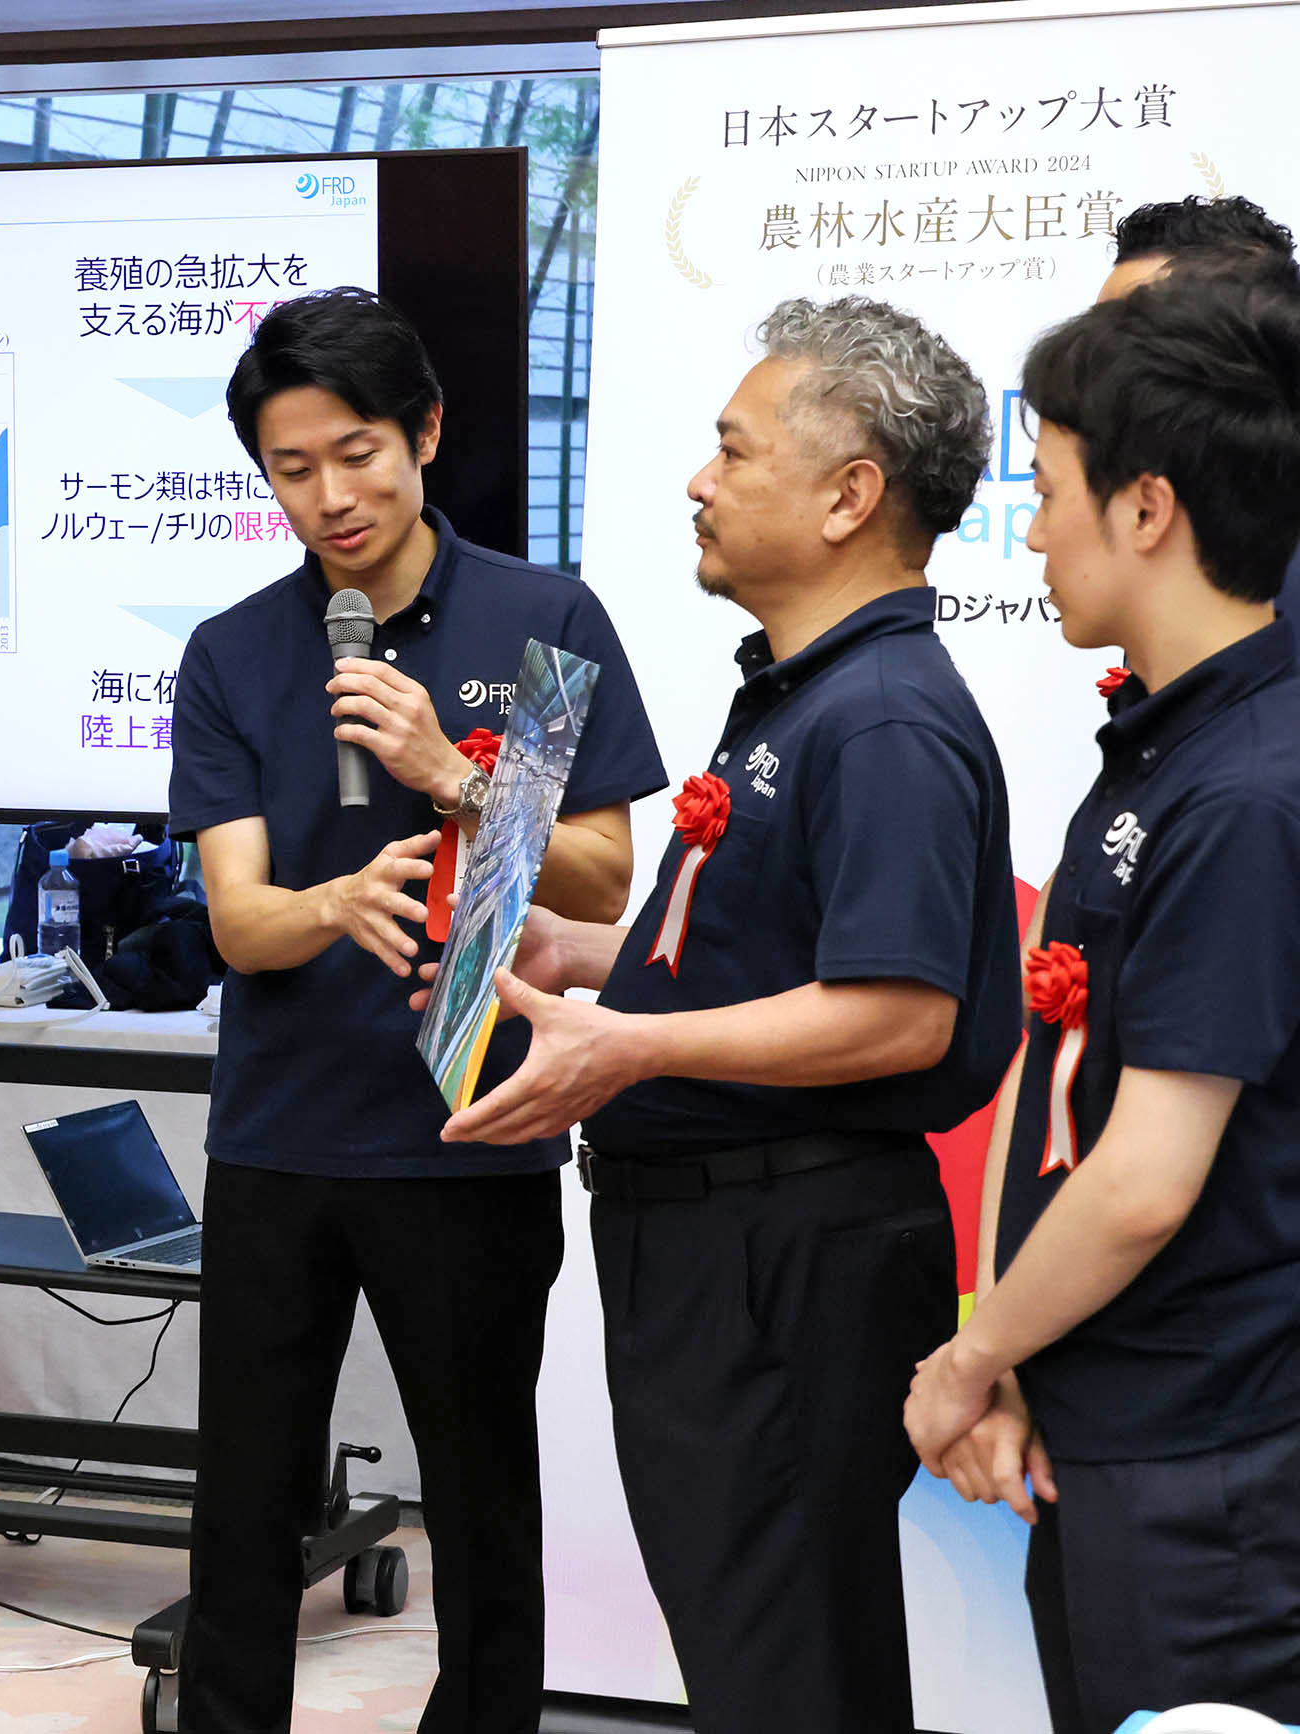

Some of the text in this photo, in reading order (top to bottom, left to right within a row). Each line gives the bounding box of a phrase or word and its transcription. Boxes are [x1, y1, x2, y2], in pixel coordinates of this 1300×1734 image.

[723, 83, 1176, 148] 日本スタートアップ大賞
[795, 154, 1092, 184] NIPPON STARTUP AWARD 2024
[322, 177, 355, 195] FRD
[331, 194, 366, 208] Japan
[759, 190, 1123, 252] 農林水産大臣賞
[74, 253, 308, 292] 養殖の急拡大を
[79, 300, 288, 337] 支える海が不
[60, 471, 278, 501] サーモン類は特に
[937, 594, 1061, 624] Dジャパ
[0, 626, 9, 650] 2013
[755, 752, 780, 779] FRD
[751, 774, 776, 799] Japan
